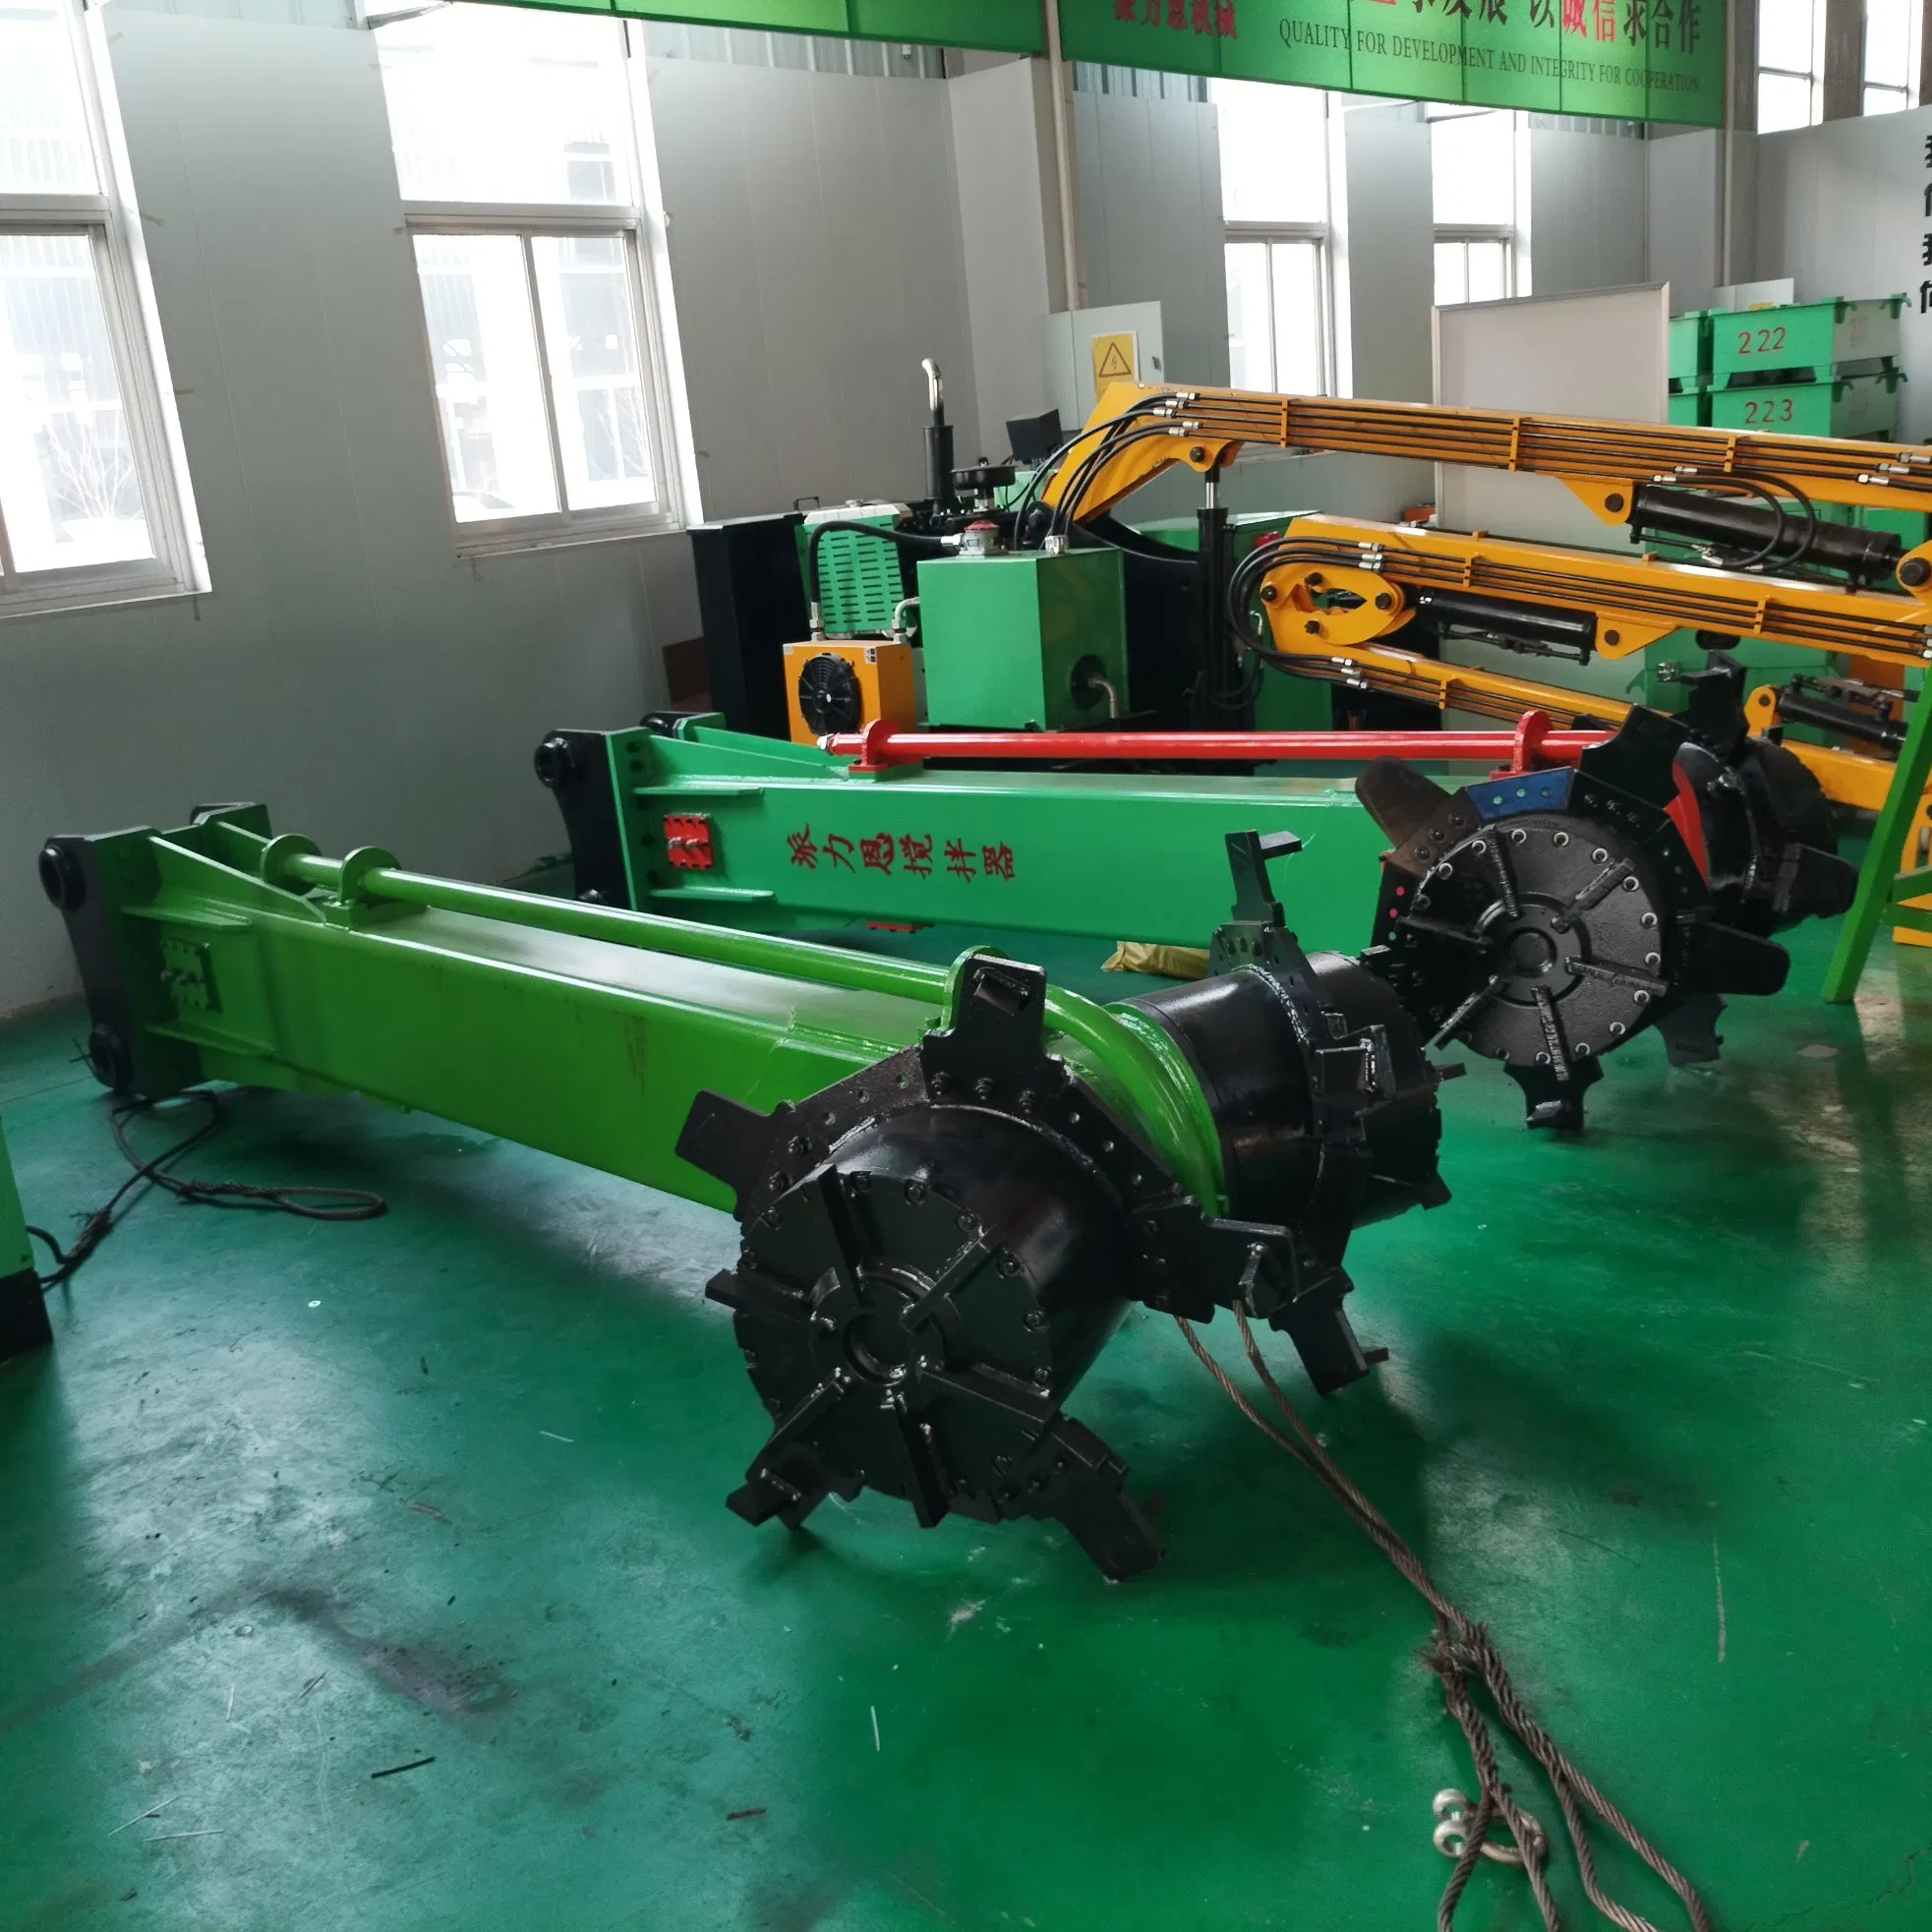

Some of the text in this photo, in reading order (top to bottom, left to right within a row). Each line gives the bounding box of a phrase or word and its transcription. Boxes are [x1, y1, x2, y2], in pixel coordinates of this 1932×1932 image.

[1279, 18, 1700, 91] QUALITY FOR DEVELOPMENT AND INTEGRITY FOR COOPERATION
[1737, 326, 1787, 355] 222
[1744, 398, 1794, 425] 223
[787, 822, 1016, 883] 派力恩搅拌器
